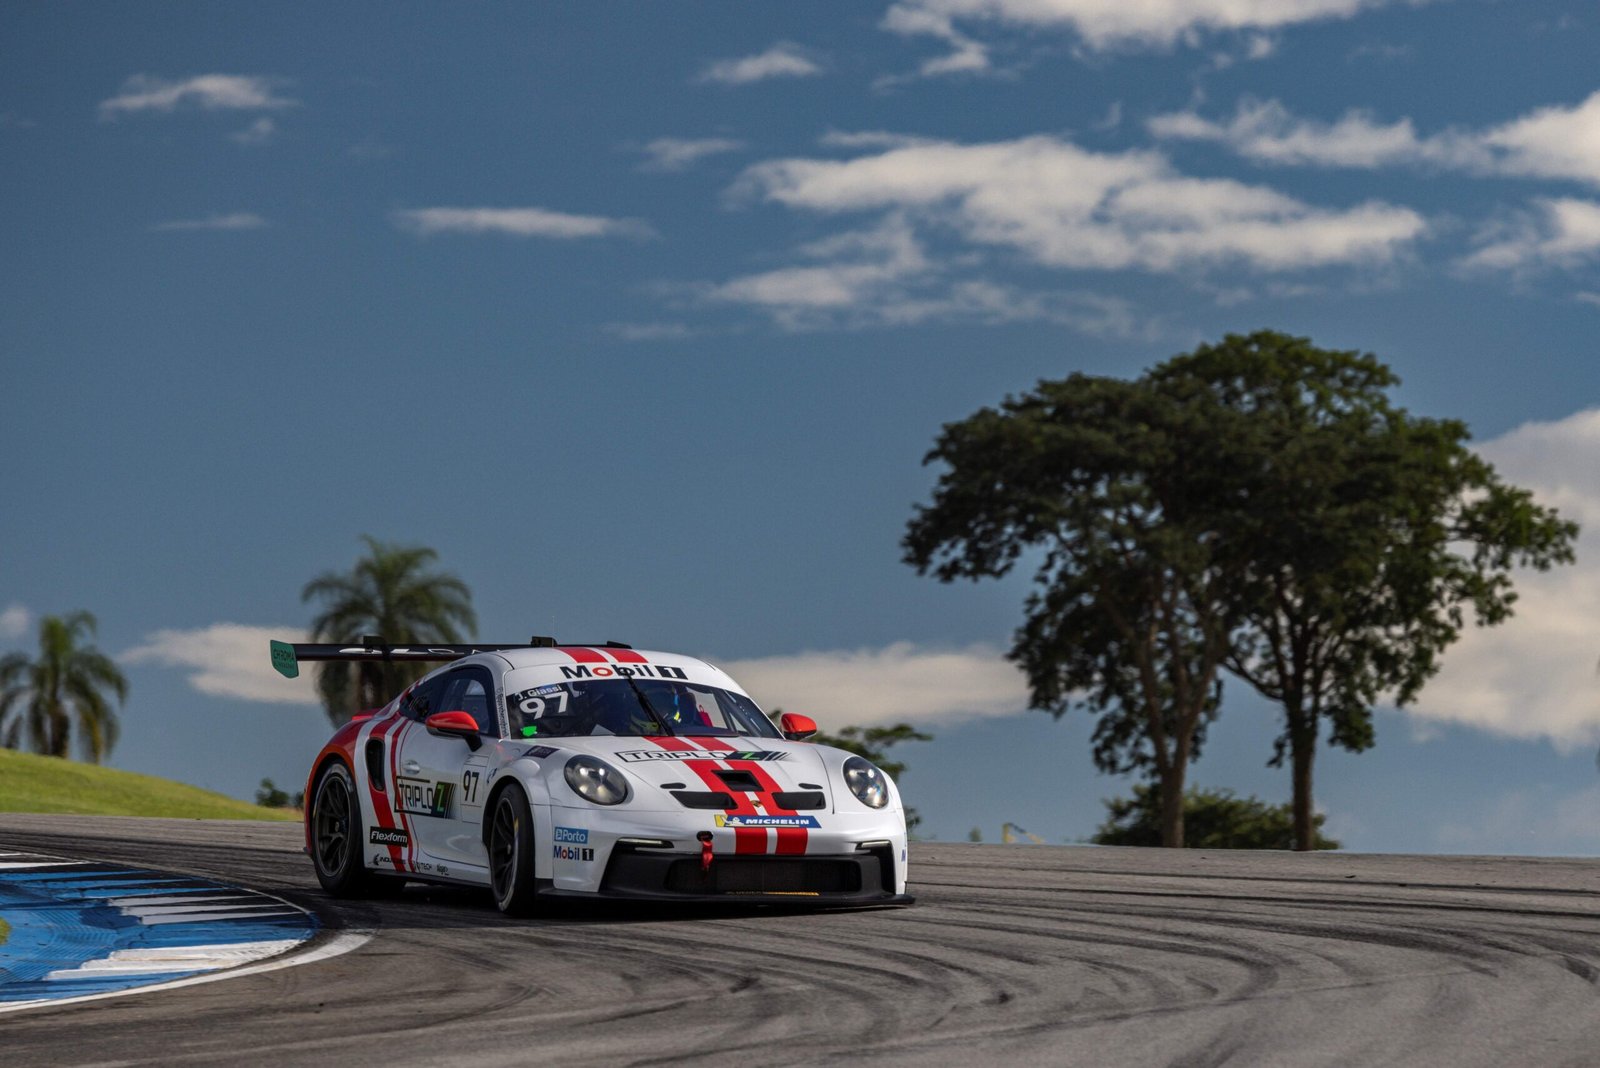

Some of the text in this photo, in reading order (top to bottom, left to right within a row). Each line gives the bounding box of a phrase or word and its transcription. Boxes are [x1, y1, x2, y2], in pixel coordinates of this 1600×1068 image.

[559, 664, 655, 679] Mobil
[519, 690, 569, 720] 97
[462, 769, 480, 803] 97
[371, 830, 408, 843] Flexform
[562, 829, 586, 842] Porto
[553, 845, 580, 860] Mobil
